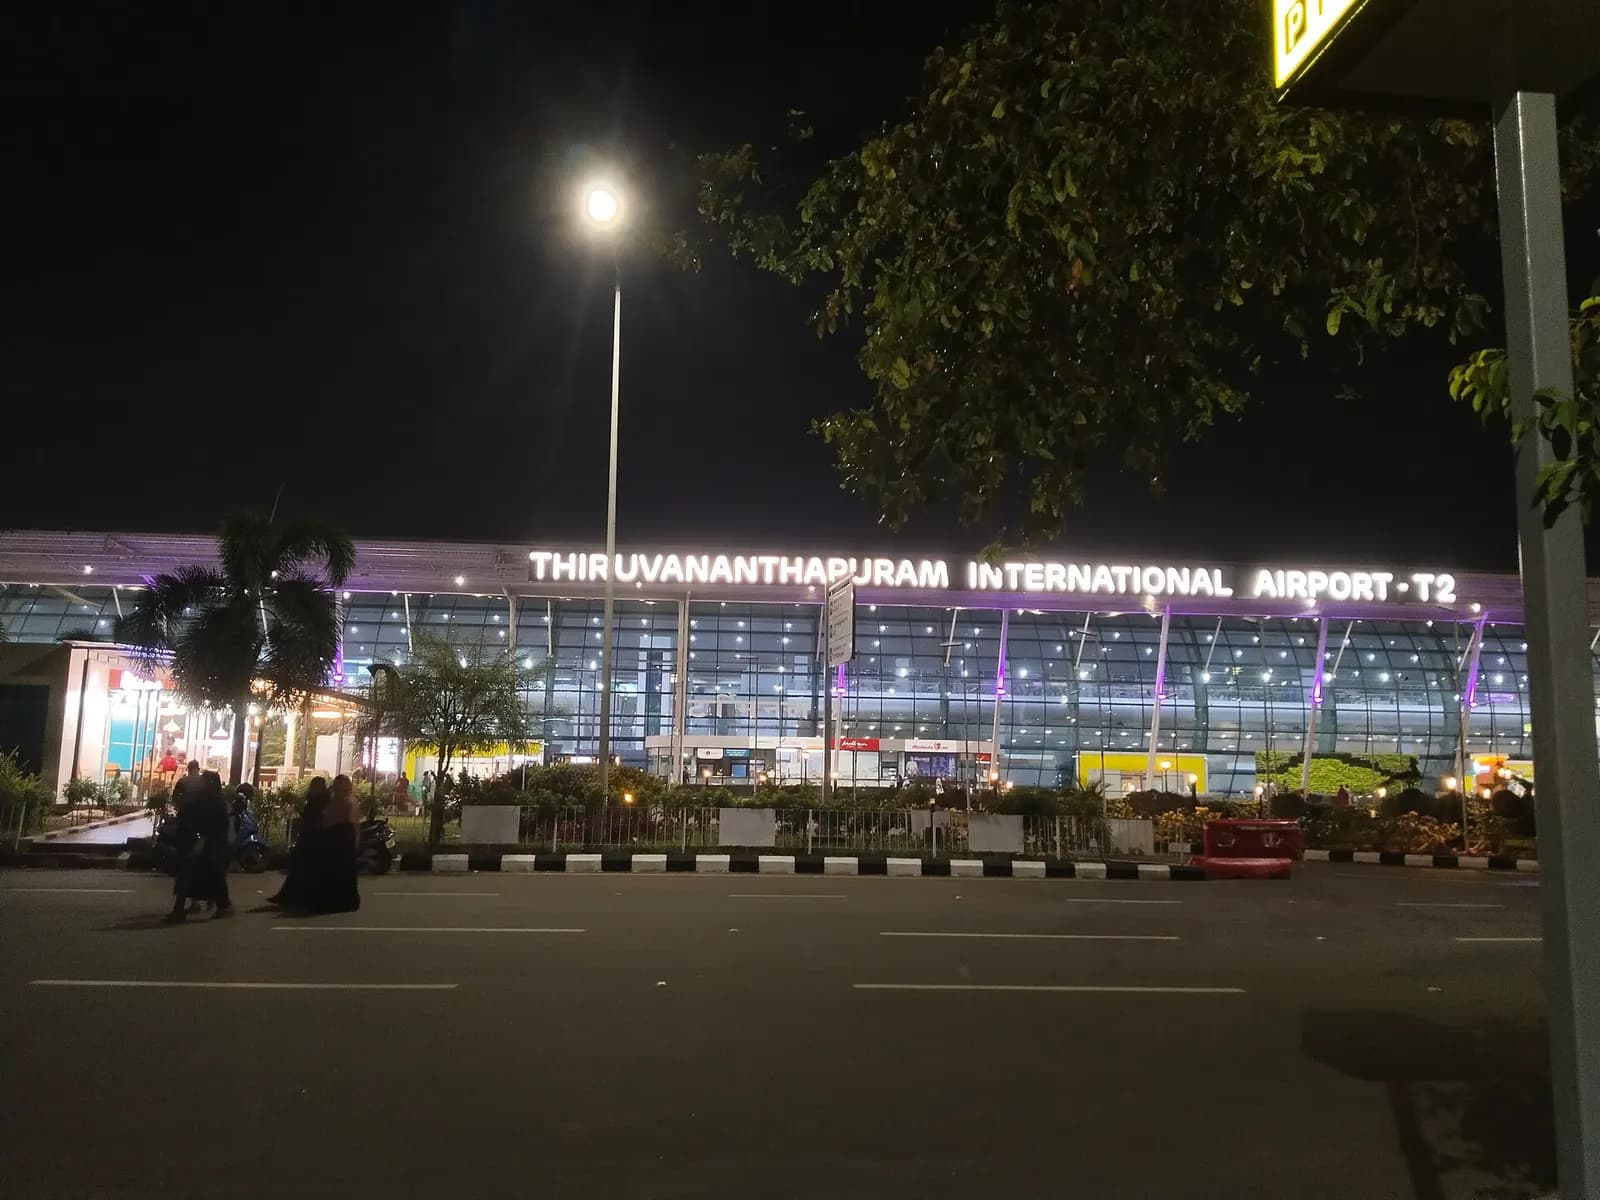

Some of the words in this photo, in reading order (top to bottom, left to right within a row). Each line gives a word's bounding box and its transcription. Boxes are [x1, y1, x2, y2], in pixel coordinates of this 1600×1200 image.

[529, 551, 949, 588] THIRUVANANTHAPURAM
[968, 561, 1233, 597] INTERNATIONAL
[1253, 569, 1393, 601] AIRPORT
